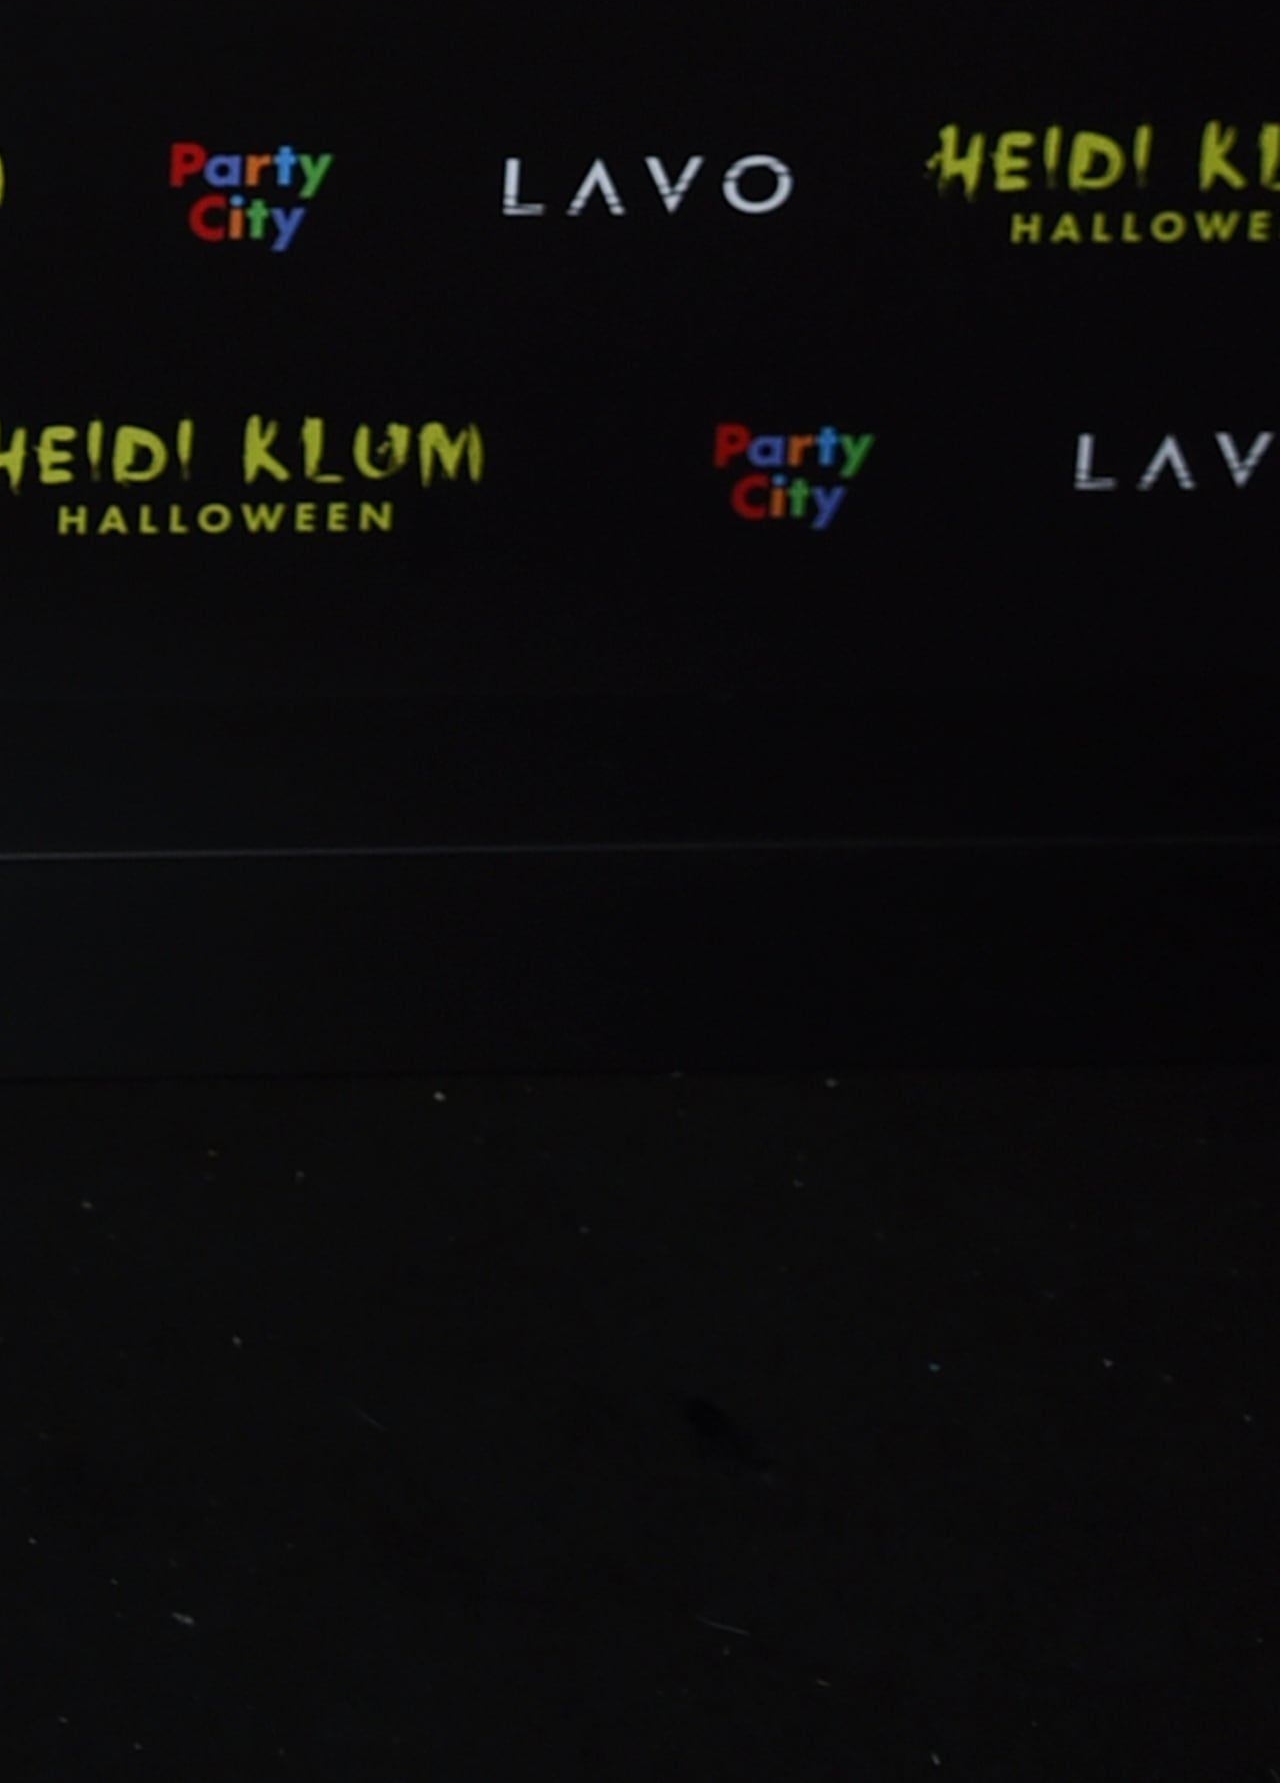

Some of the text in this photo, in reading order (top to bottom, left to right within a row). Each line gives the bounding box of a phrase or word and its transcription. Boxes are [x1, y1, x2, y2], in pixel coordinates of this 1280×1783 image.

[170, 142, 332, 198] Party
[503, 155, 793, 215] LAVO
[927, 125, 1151, 195] HEIDI
[189, 194, 305, 252] City
[244, 415, 482, 485] KLUM
[715, 424, 872, 477] Party
[58, 502, 392, 534] HALLOWEEN
[732, 474, 844, 529] City
